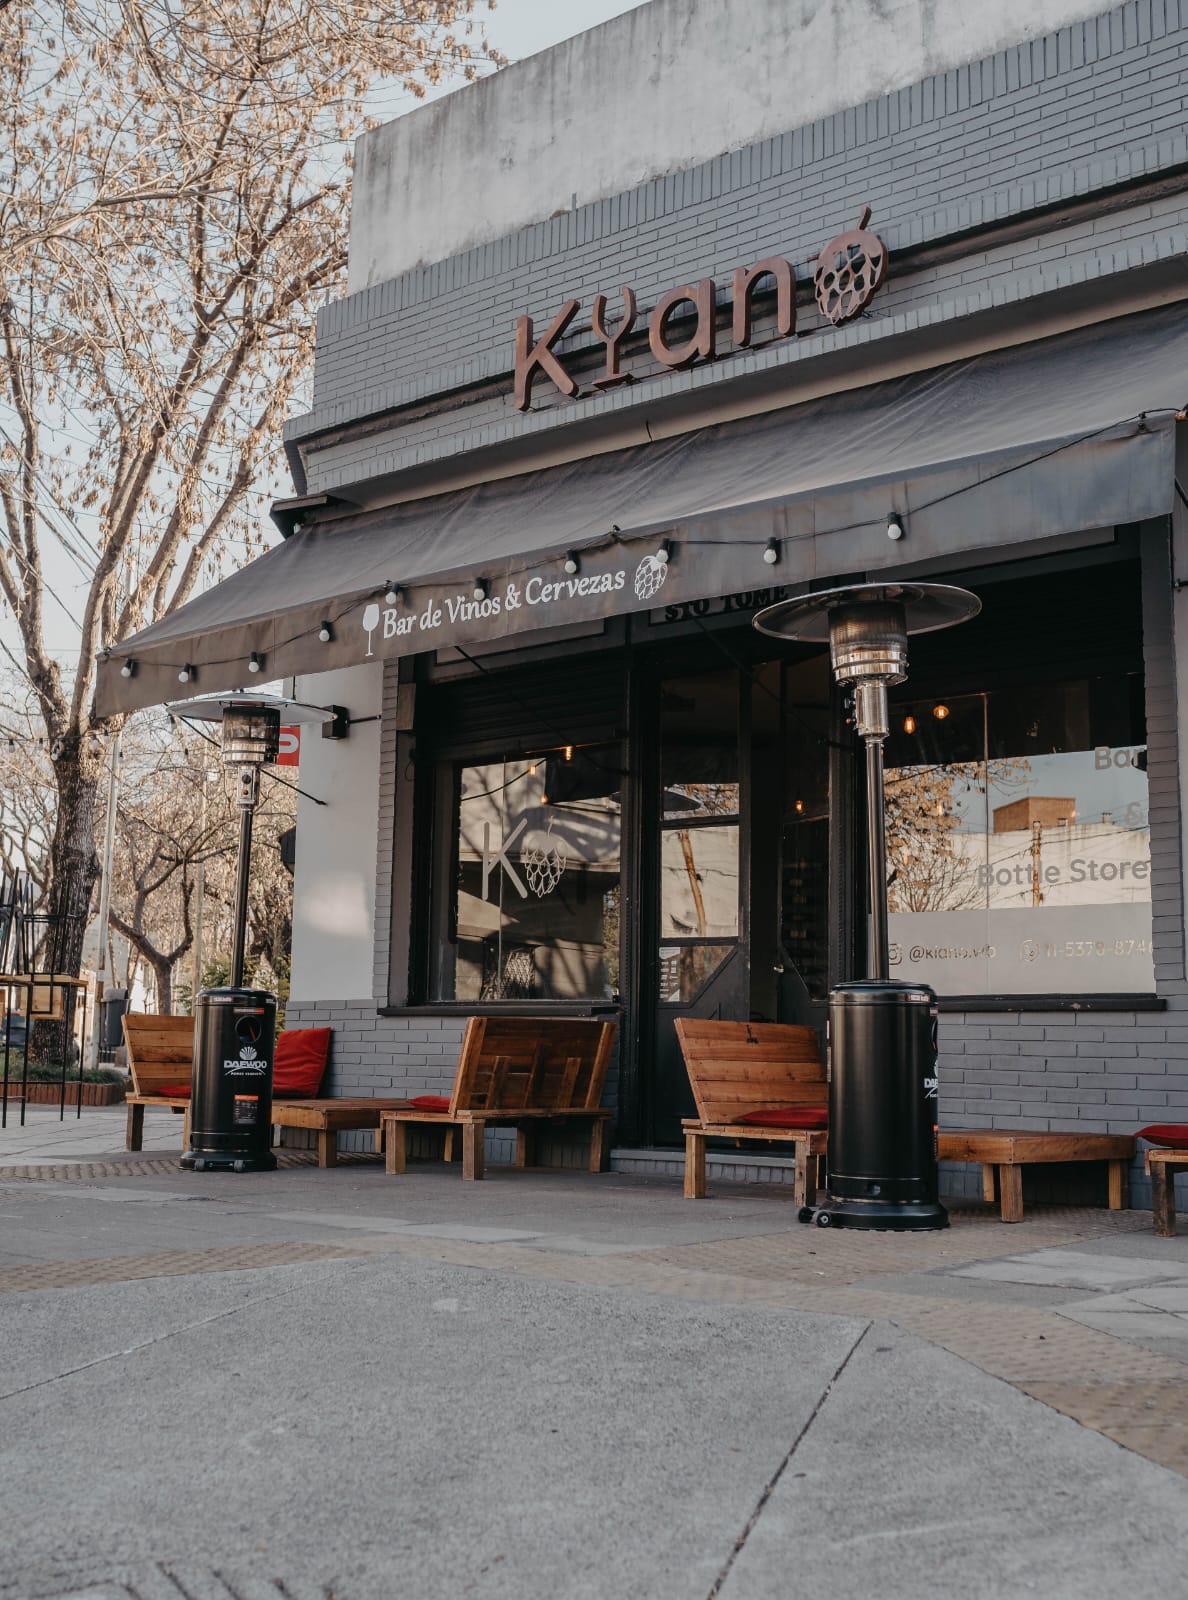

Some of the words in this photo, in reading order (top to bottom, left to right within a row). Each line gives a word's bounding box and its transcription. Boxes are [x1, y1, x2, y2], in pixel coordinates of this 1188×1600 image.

[382, 608, 417, 639] Bar
[419, 599, 442, 631] de
[444, 595, 501, 624] Vinos
[505, 583, 522, 611] &
[525, 570, 626, 605] Cervezas
[1094, 746, 1144, 770] Bar
[977, 859, 1061, 888] Bottle
[1070, 858, 1149, 883] Store
[223, 1060, 268, 1069] DAEWOO
